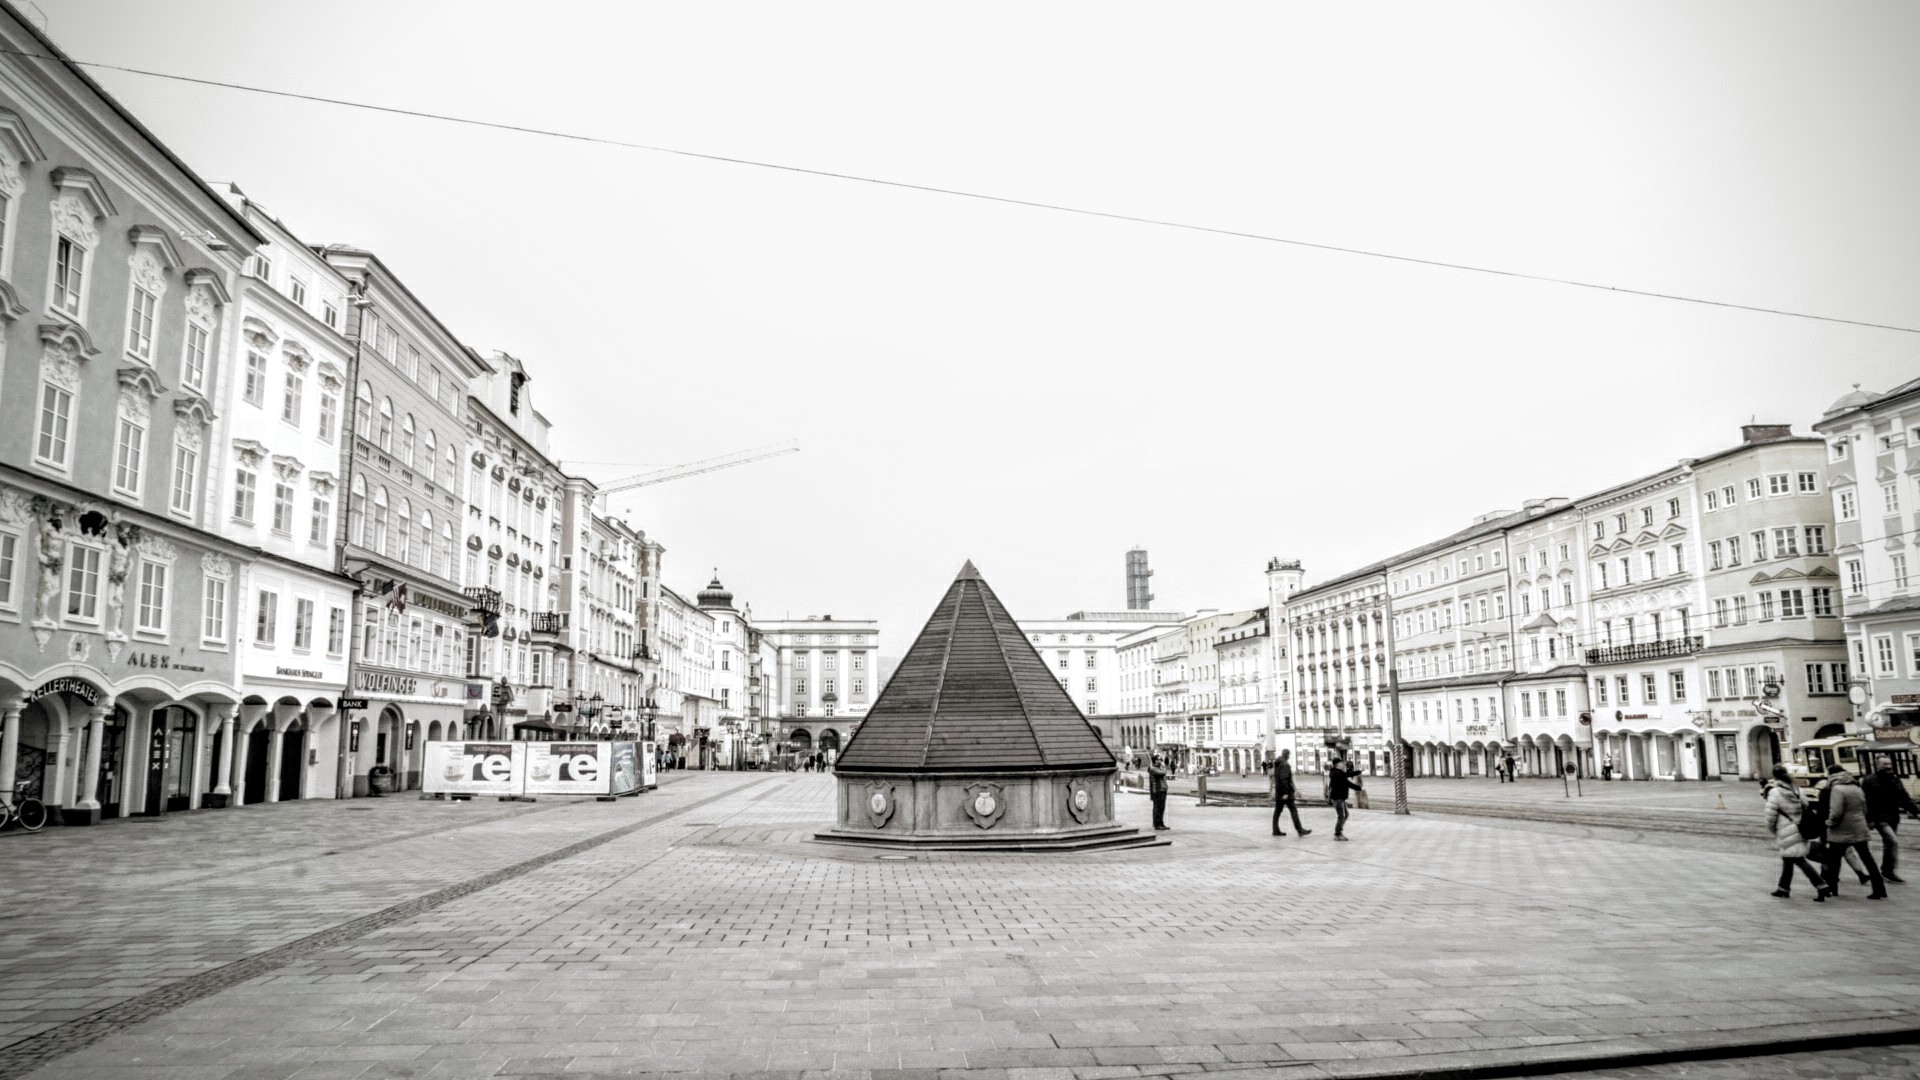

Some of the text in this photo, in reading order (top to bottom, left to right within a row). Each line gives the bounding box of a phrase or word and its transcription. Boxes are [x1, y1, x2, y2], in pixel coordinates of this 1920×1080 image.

[127, 652, 170, 669] ALEX
[30, 678, 99, 706] KELLERTHEATER
[342, 700, 363, 708] BANK
[352, 723, 360, 751] HOTEL
[1874, 728, 1910, 740] Stadtrund
[464, 754, 512, 782] re
[549, 753, 597, 781] re
